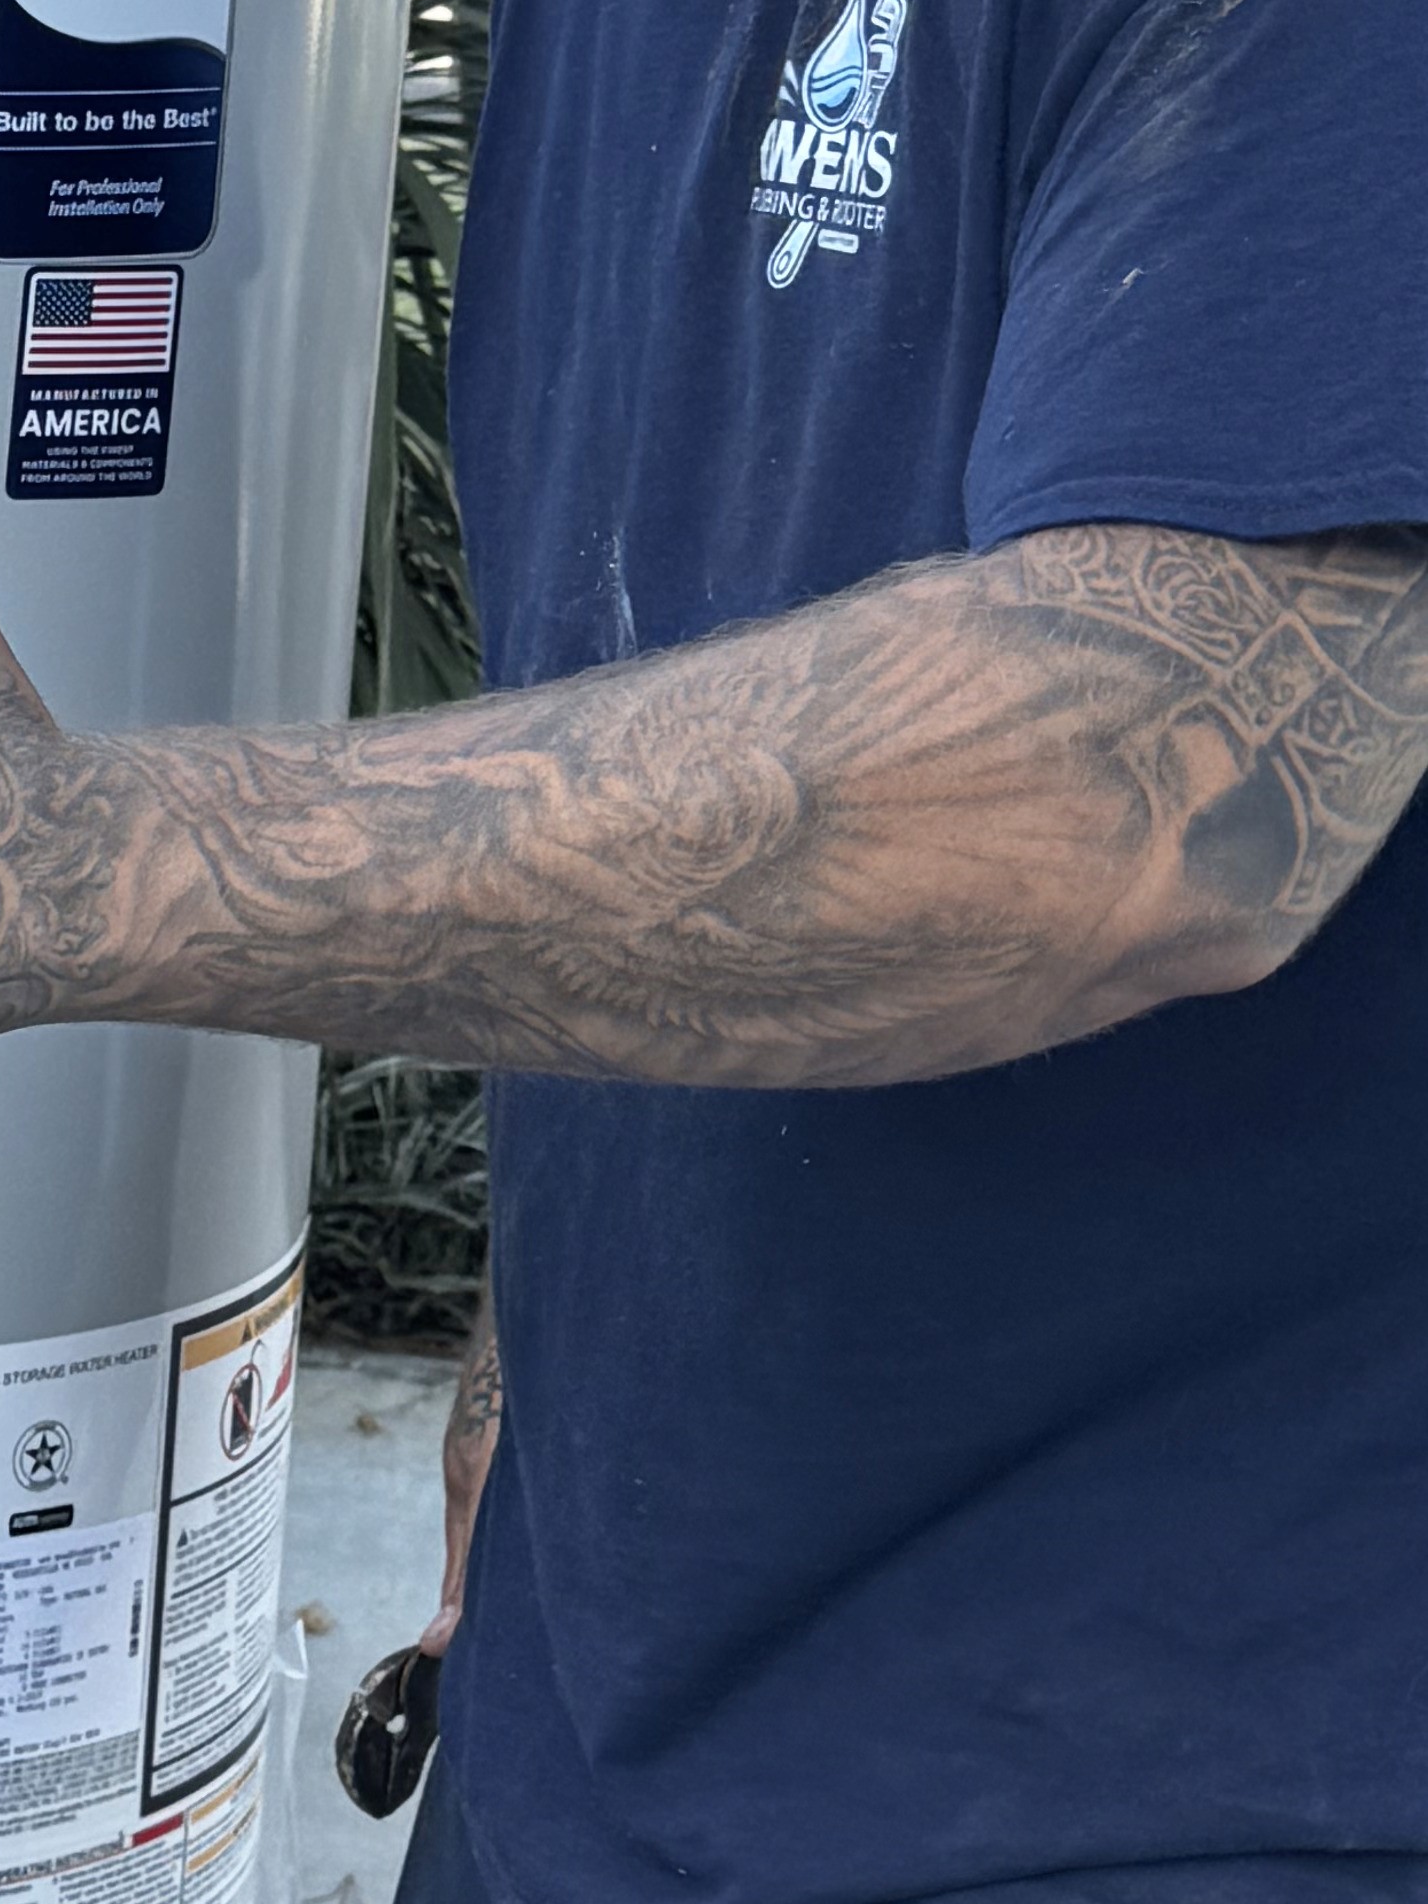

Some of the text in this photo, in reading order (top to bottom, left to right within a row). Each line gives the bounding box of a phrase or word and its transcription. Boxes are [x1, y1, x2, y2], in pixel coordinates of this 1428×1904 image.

[55, 112, 78, 131] to
[85, 110, 114, 131] be
[123, 109, 156, 130] the
[50, 176, 163, 196] For Professional
[48, 197, 165, 217] Installation Only
[19, 407, 161, 437] AMERICA
